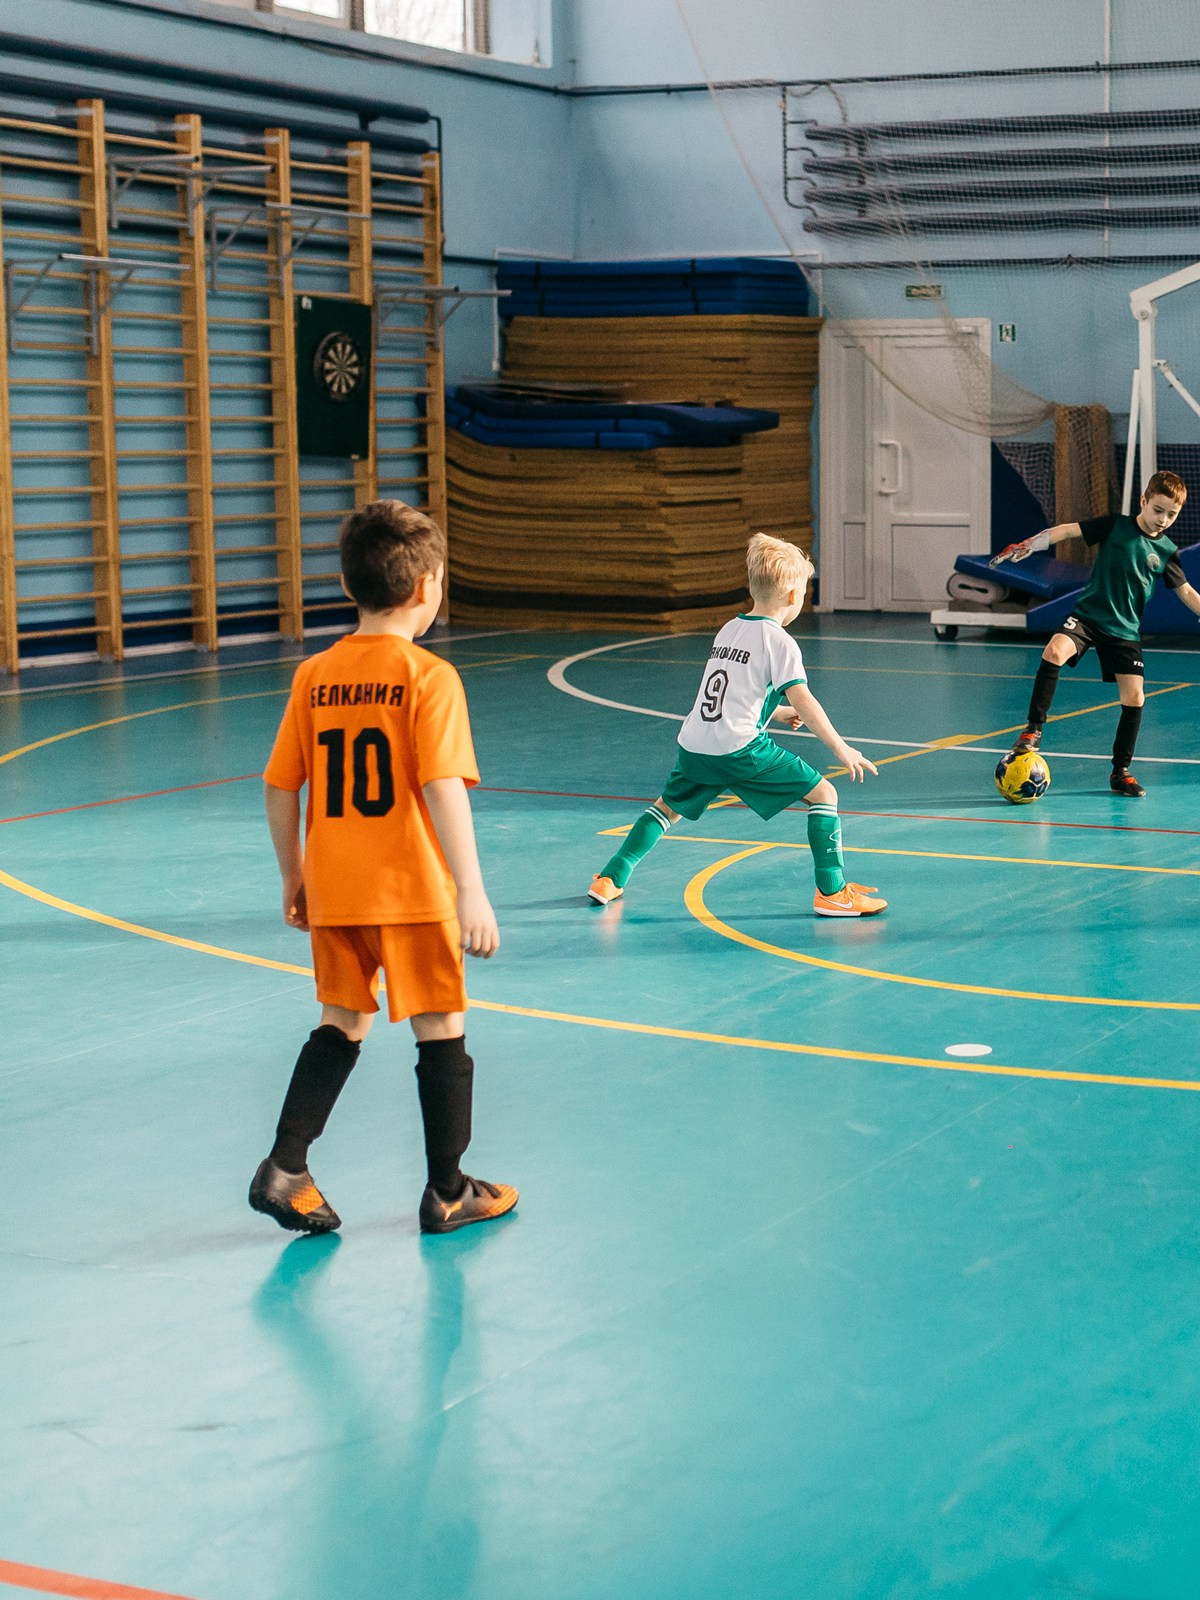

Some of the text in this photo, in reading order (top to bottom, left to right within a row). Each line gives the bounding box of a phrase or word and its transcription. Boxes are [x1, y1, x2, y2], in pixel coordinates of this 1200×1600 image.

[1063, 616, 1079, 630] 5
[700, 669, 729, 722] 9
[318, 727, 395, 817] 10
